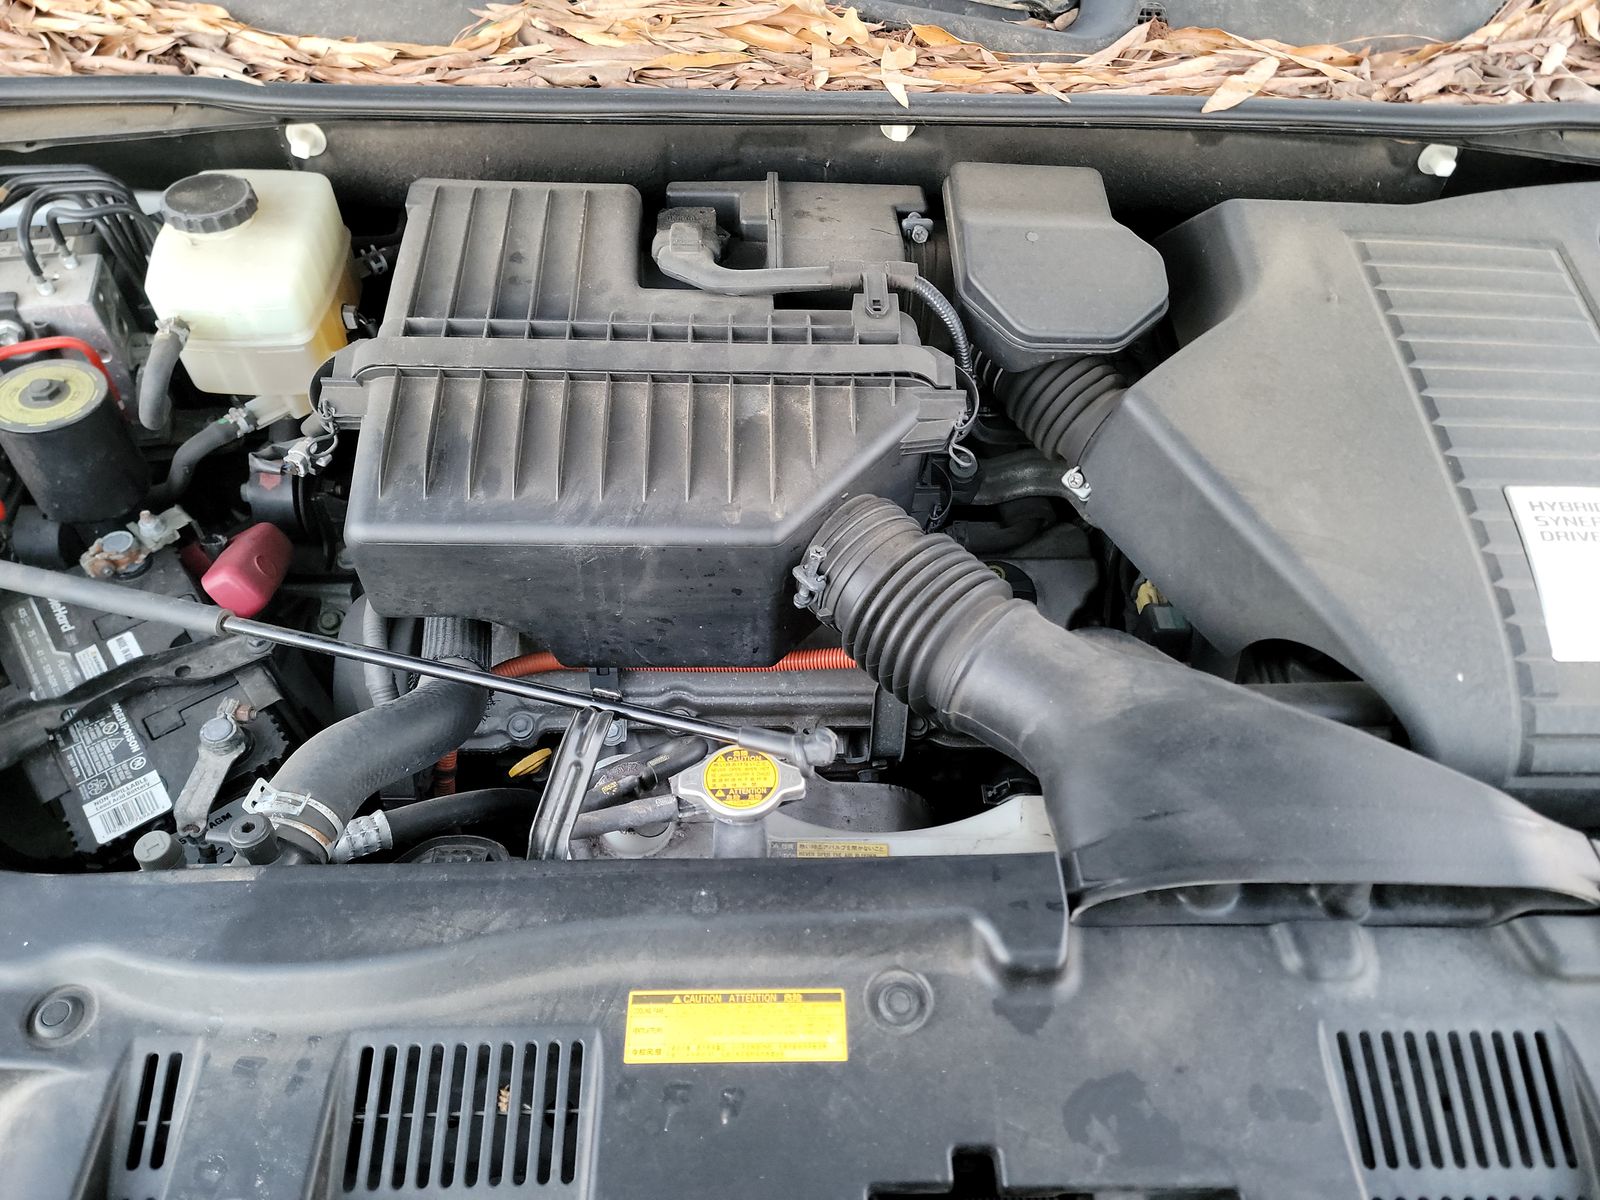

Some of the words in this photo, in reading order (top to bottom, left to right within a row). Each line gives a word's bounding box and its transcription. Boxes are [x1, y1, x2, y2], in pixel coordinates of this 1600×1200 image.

[209, 812, 233, 829] AGM
[683, 994, 722, 1004] CAUTION
[728, 993, 777, 1003] ATTENTION
